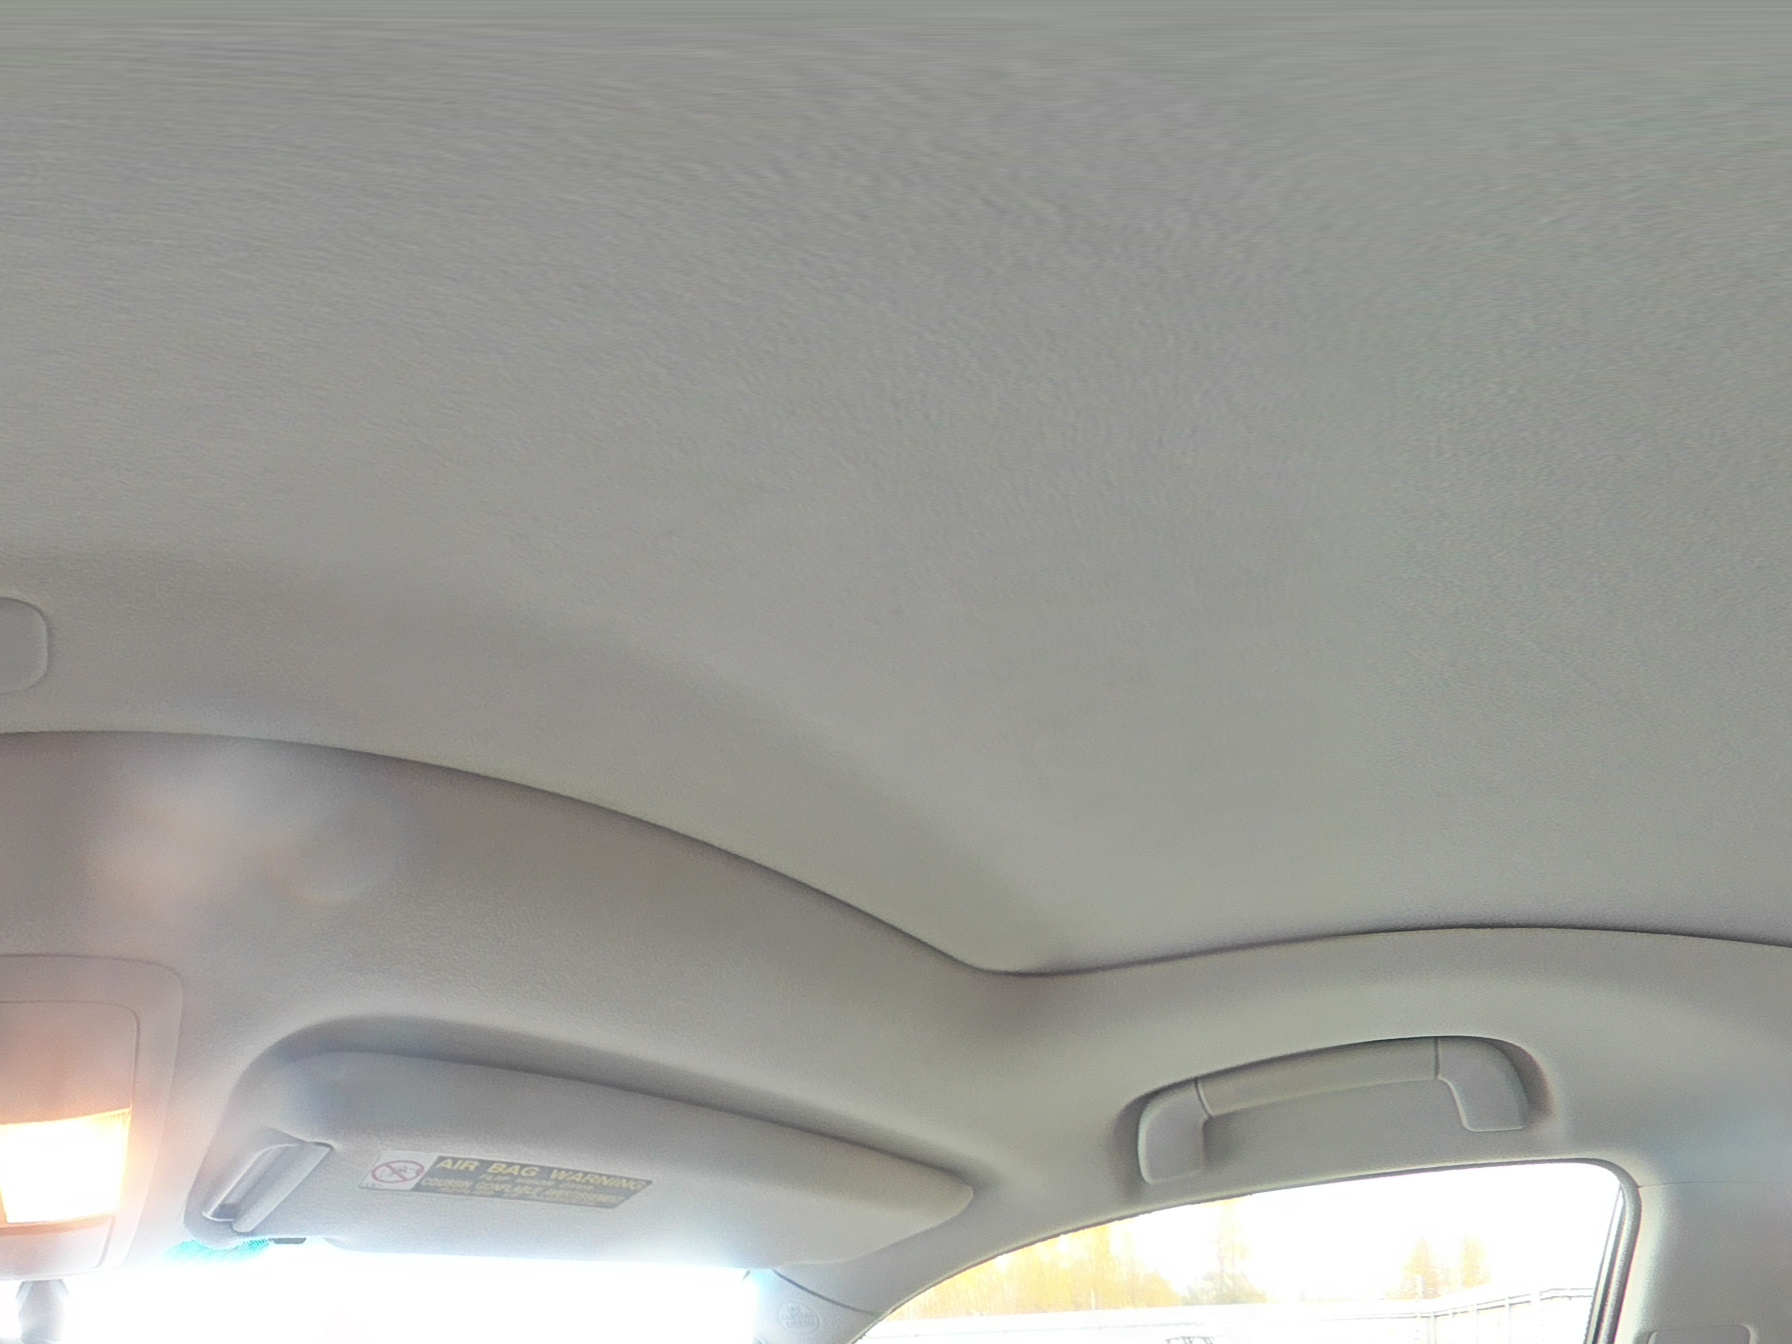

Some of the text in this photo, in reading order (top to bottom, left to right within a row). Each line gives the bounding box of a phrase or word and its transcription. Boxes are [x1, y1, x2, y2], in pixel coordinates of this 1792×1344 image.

[434, 1158, 648, 1191] AIR BAG WARNING
